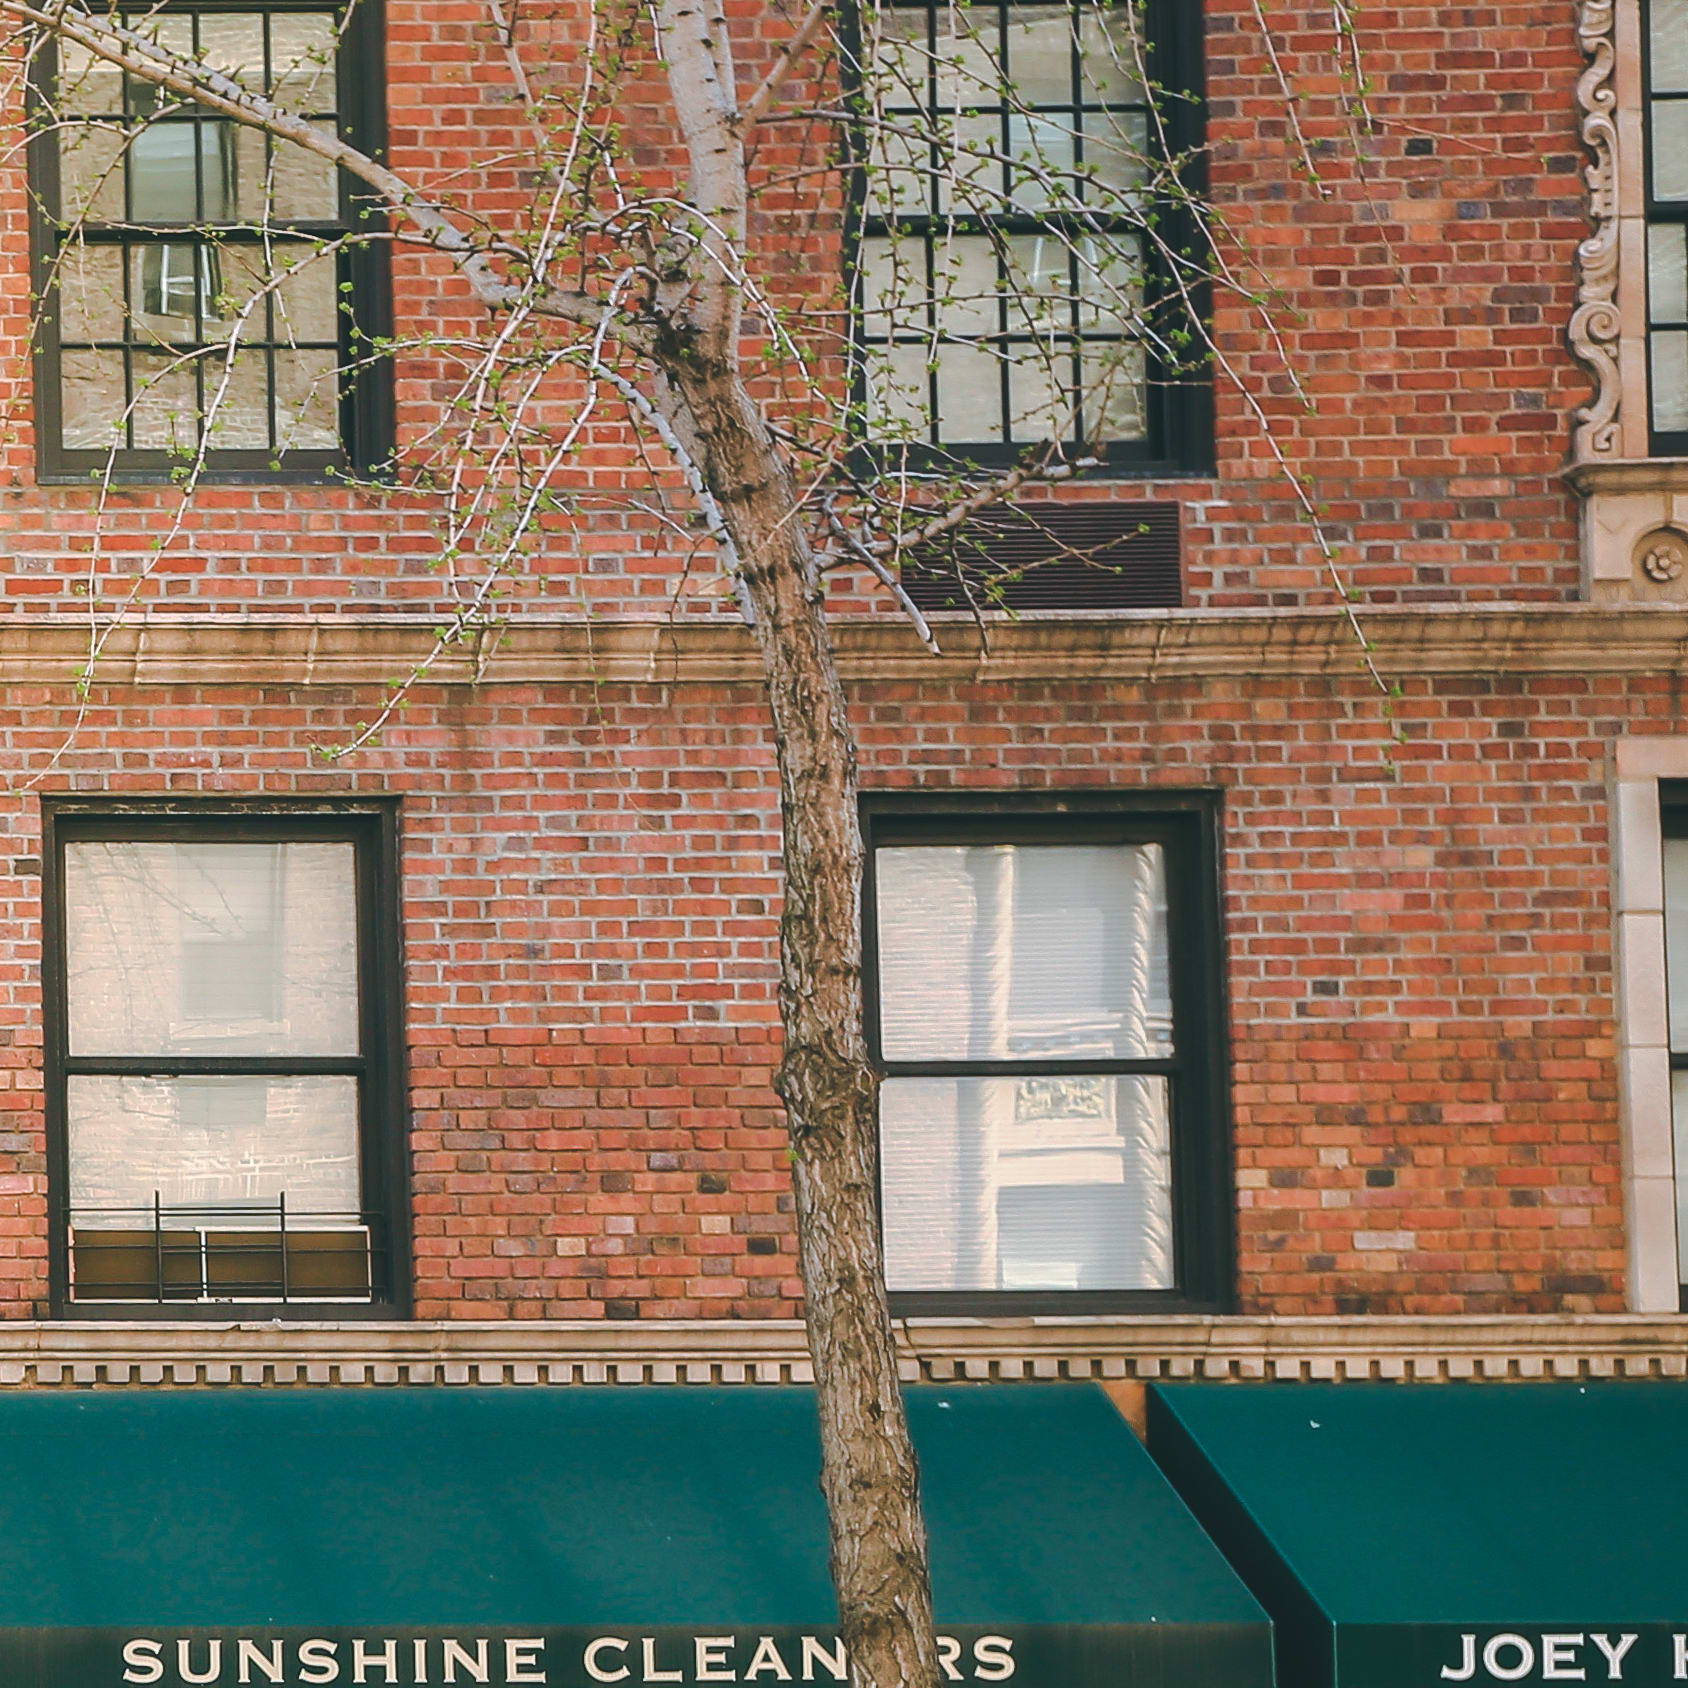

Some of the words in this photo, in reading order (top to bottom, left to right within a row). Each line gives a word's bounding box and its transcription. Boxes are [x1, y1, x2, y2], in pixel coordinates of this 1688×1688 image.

[121, 1637, 548, 1686] SUNSHINE
[583, 1634, 1017, 1684] CLEANRS
[1440, 1632, 1639, 1681] JOEY
